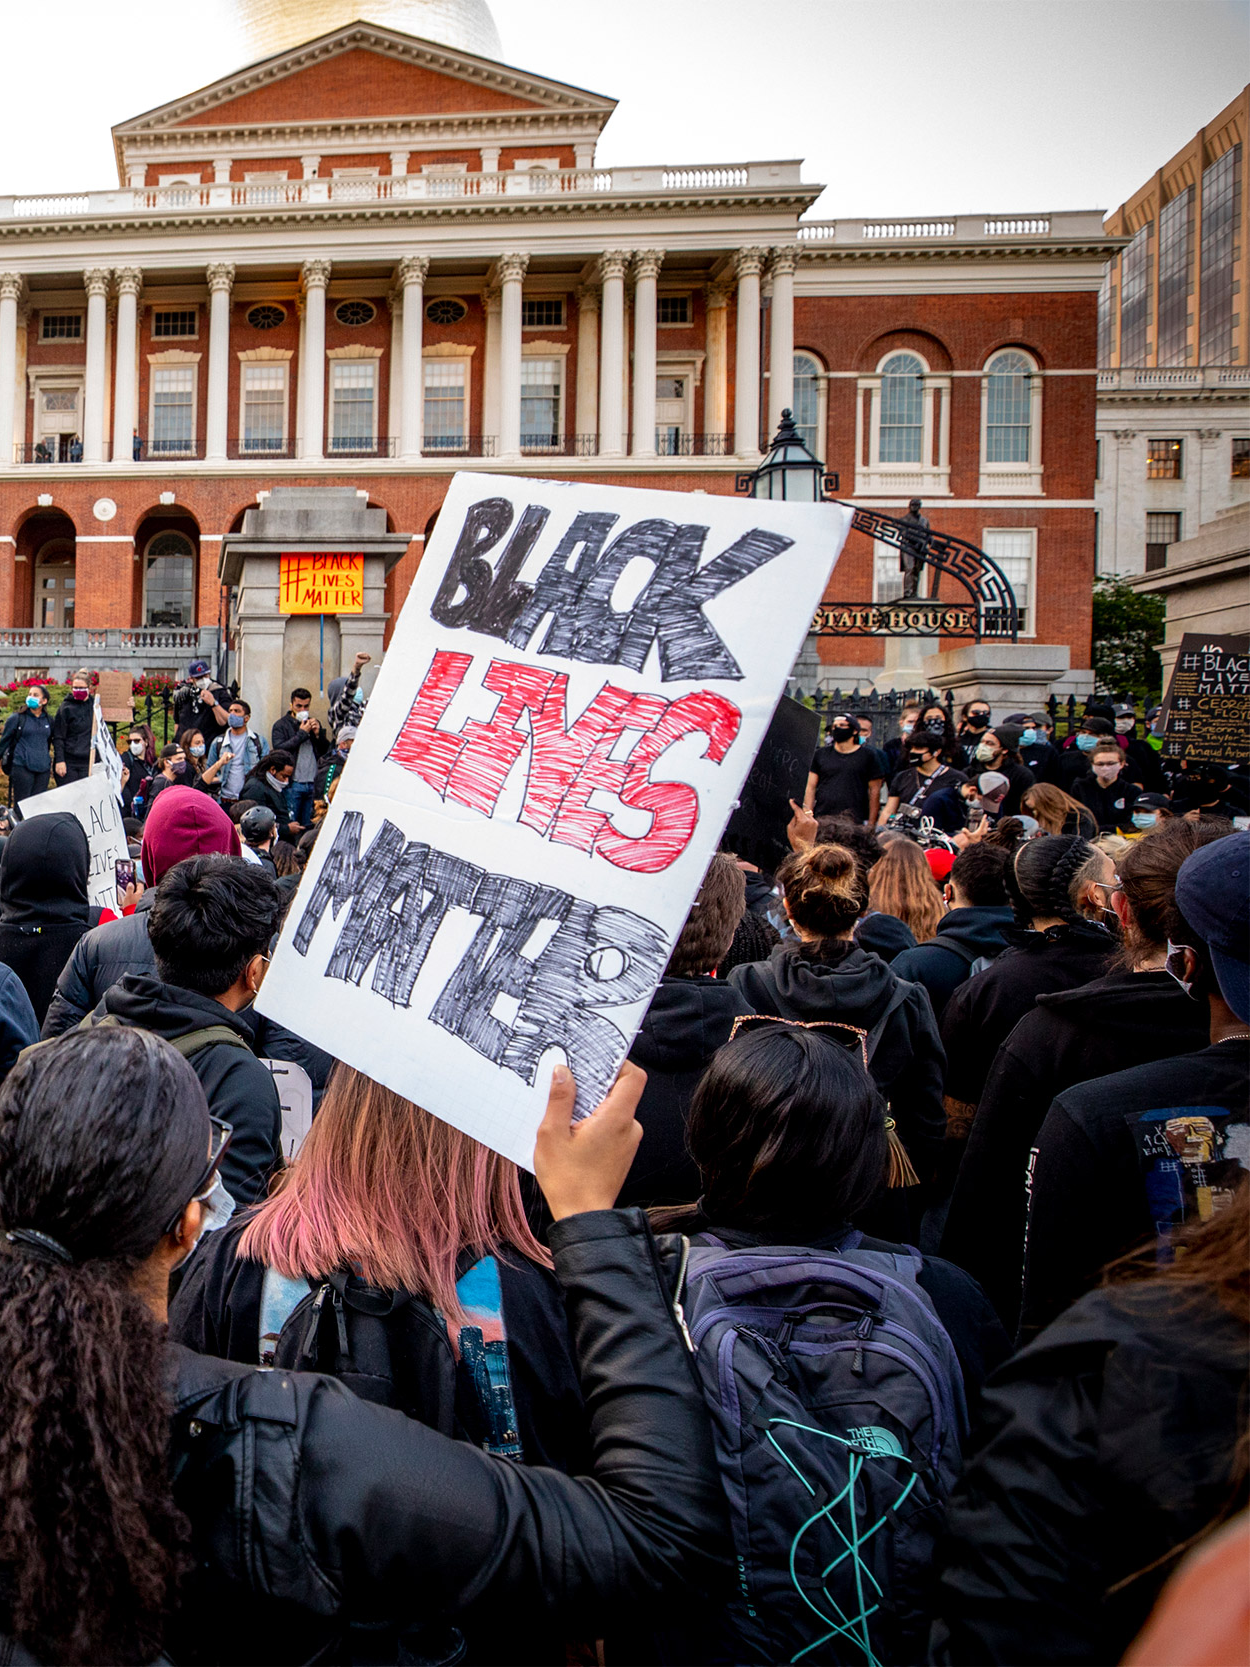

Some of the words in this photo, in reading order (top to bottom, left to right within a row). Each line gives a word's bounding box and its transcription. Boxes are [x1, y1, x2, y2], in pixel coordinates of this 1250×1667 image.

[312, 553, 359, 571] BLACK
[312, 574, 355, 587] LIVES
[429, 497, 795, 682] BLACK
[302, 588, 362, 608] MATTER
[812, 612, 880, 628] STATE
[889, 612, 971, 628] HOUSE
[383, 649, 742, 874] LIVES
[292, 811, 671, 1121] MATTER
[847, 1427, 872, 1439] THE
